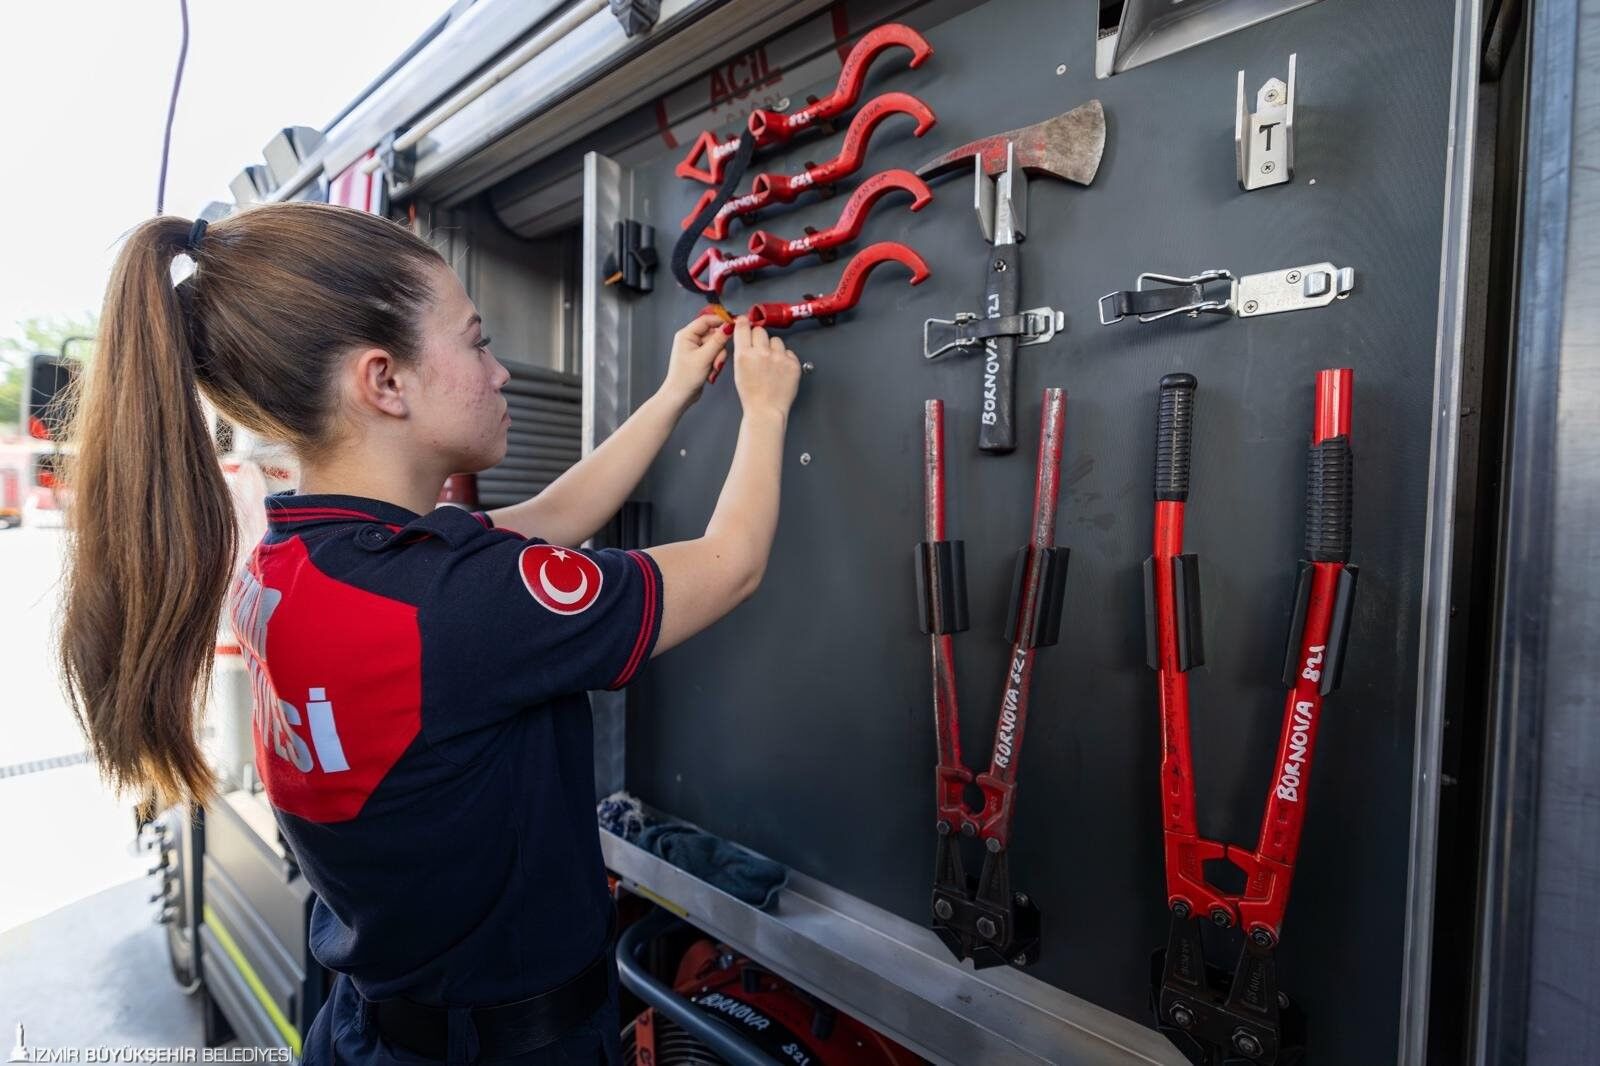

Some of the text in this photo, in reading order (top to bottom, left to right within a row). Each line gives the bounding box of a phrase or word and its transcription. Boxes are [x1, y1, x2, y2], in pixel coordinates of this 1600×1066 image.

[981, 337, 1000, 426] BORNOVA
[995, 648, 1028, 768] BORNOVA 821
[1276, 644, 1326, 802] BORNOVA 821
[700, 993, 771, 1031] BORNOVA
